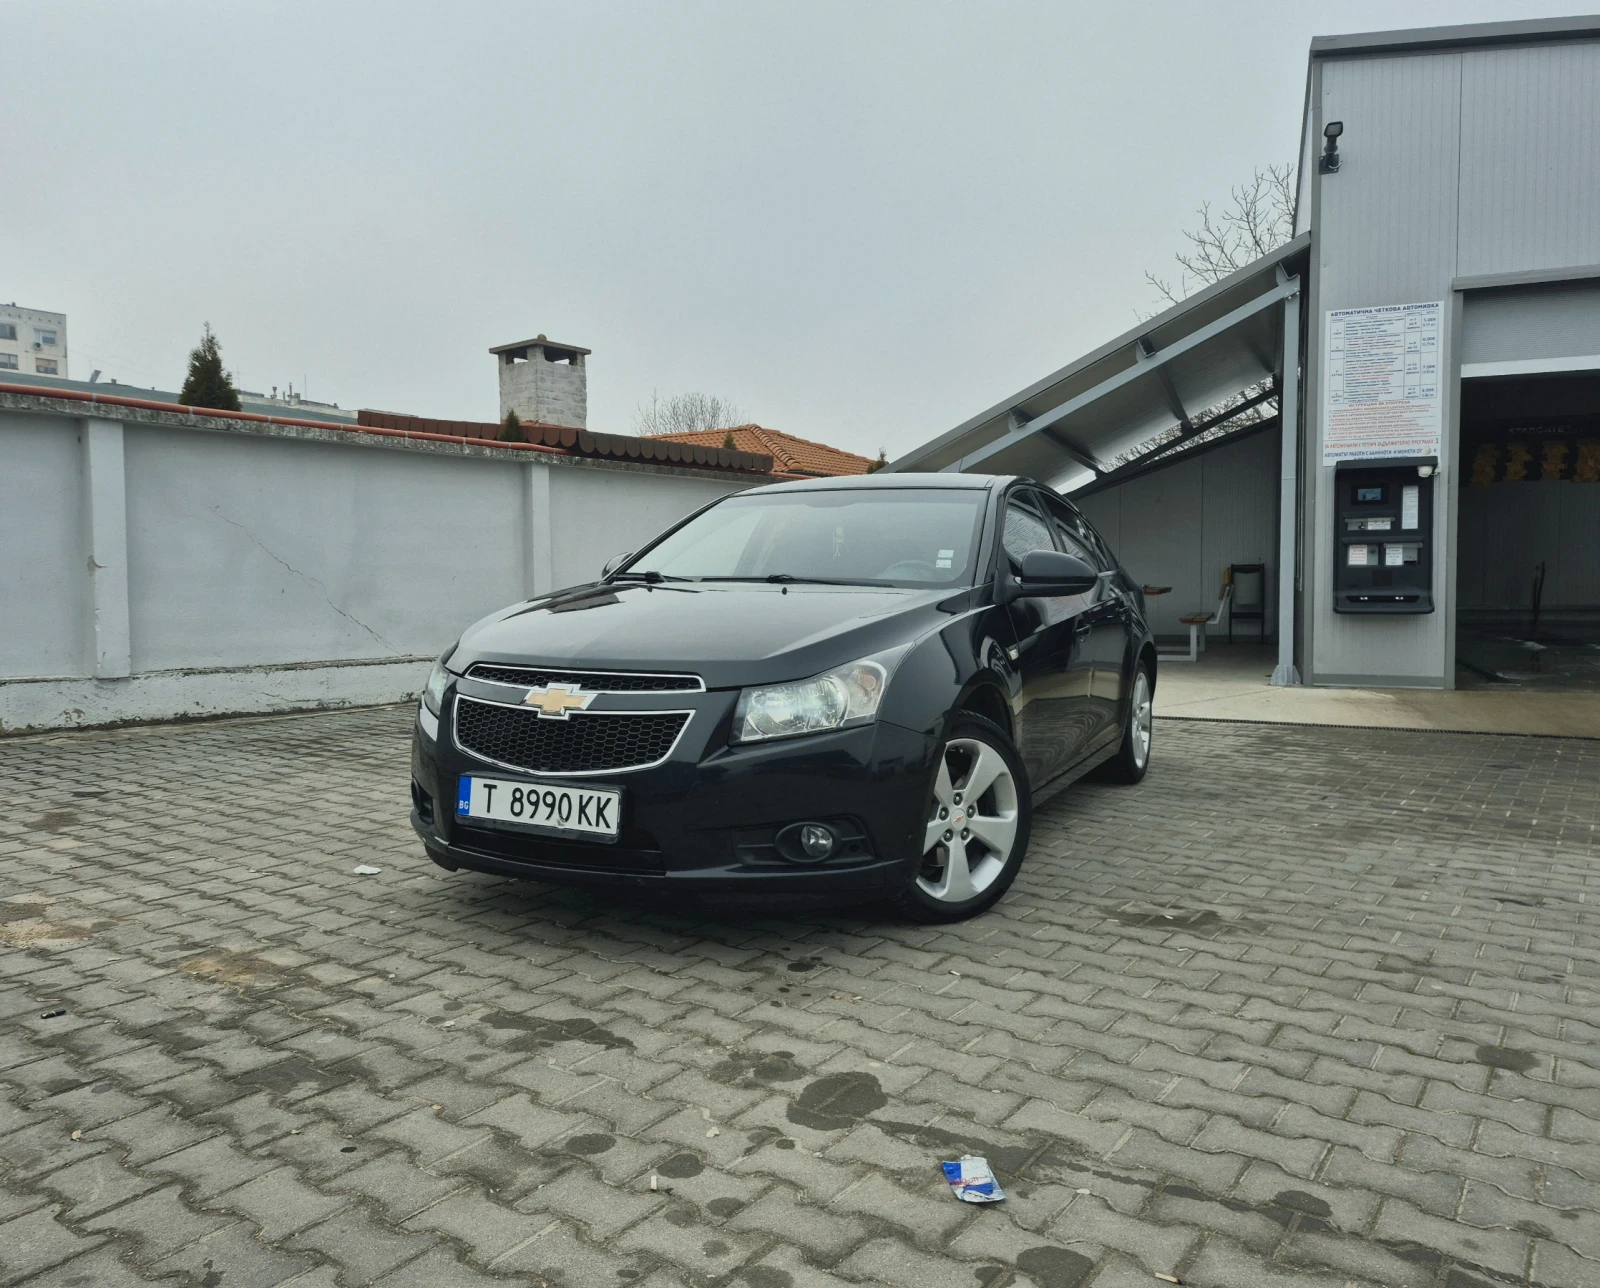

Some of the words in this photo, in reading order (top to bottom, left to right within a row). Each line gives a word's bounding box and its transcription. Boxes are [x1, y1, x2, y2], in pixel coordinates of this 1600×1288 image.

[1330, 309, 1373, 317] АВТОМАТИЧНА
[1402, 303, 1439, 311] АВТОМИВКА
[459, 800, 469, 809] BG
